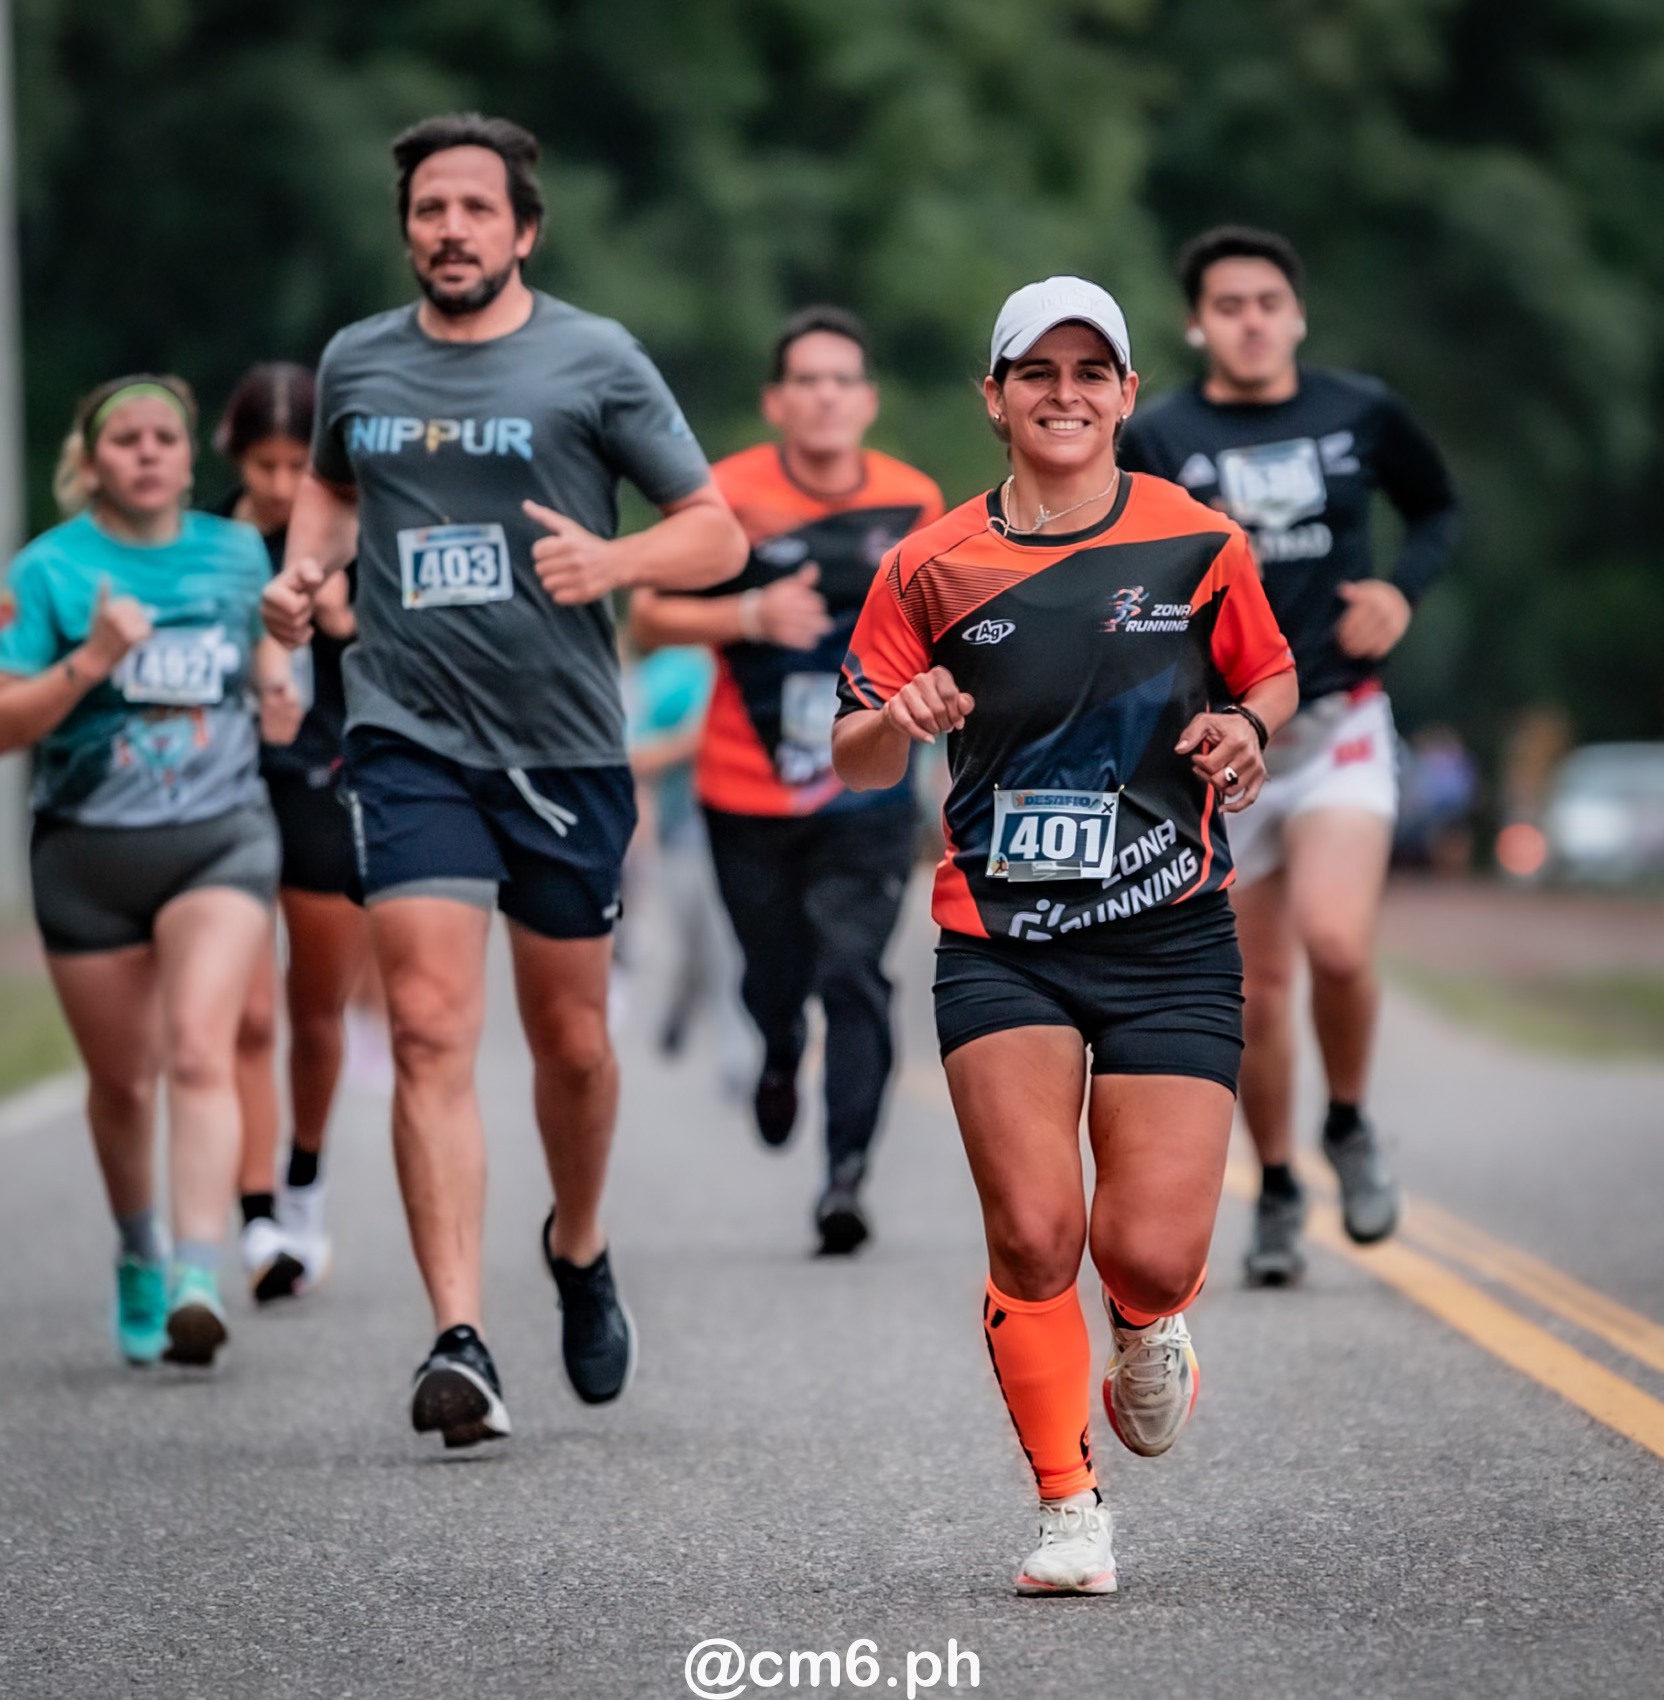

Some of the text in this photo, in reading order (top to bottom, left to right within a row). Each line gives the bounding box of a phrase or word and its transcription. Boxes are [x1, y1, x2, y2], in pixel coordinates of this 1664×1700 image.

[349, 416, 534, 461] NIPPUR
[418, 543, 498, 589] 403
[1125, 619, 1190, 633] RUNNING
[1151, 603, 1192, 617] ZONA
[1008, 815, 1103, 863] 401
